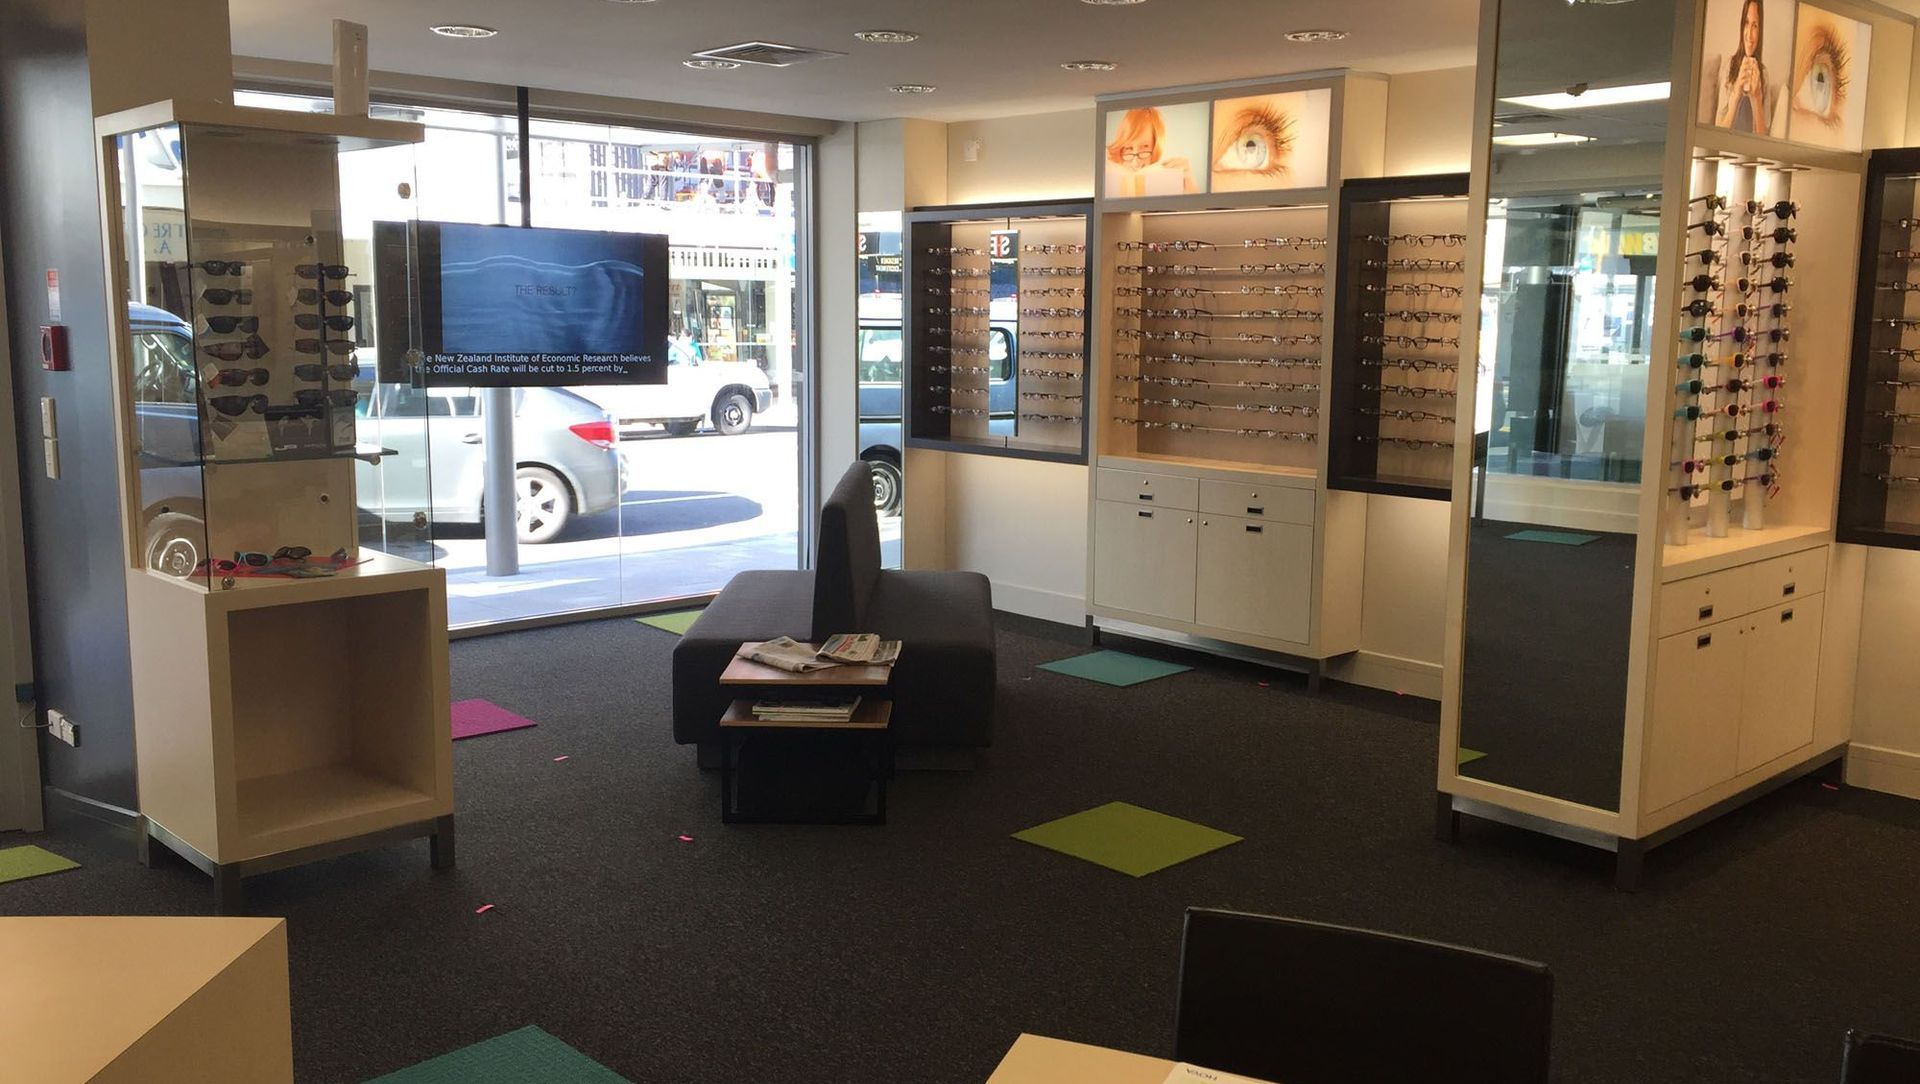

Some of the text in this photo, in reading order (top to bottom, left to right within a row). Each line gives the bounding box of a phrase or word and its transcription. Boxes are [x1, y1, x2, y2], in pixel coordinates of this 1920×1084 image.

[515, 285, 535, 297] THE
[435, 353, 455, 363] New
[457, 353, 492, 363] Zealand
[494, 353, 529, 363] Institute
[531, 353, 541, 363] of
[542, 353, 580, 363] Economic
[583, 353, 618, 363] Research
[620, 353, 651, 363] believes
[433, 364, 464, 373] Official
[466, 364, 488, 373] Cash
[490, 364, 510, 373] Rate
[512, 364, 526, 373] will
[528, 364, 539, 373] be
[541, 364, 554, 373] cut
[556, 365, 565, 373] to
[567, 364, 580, 373] 1.5
[581, 365, 611, 374] percent
